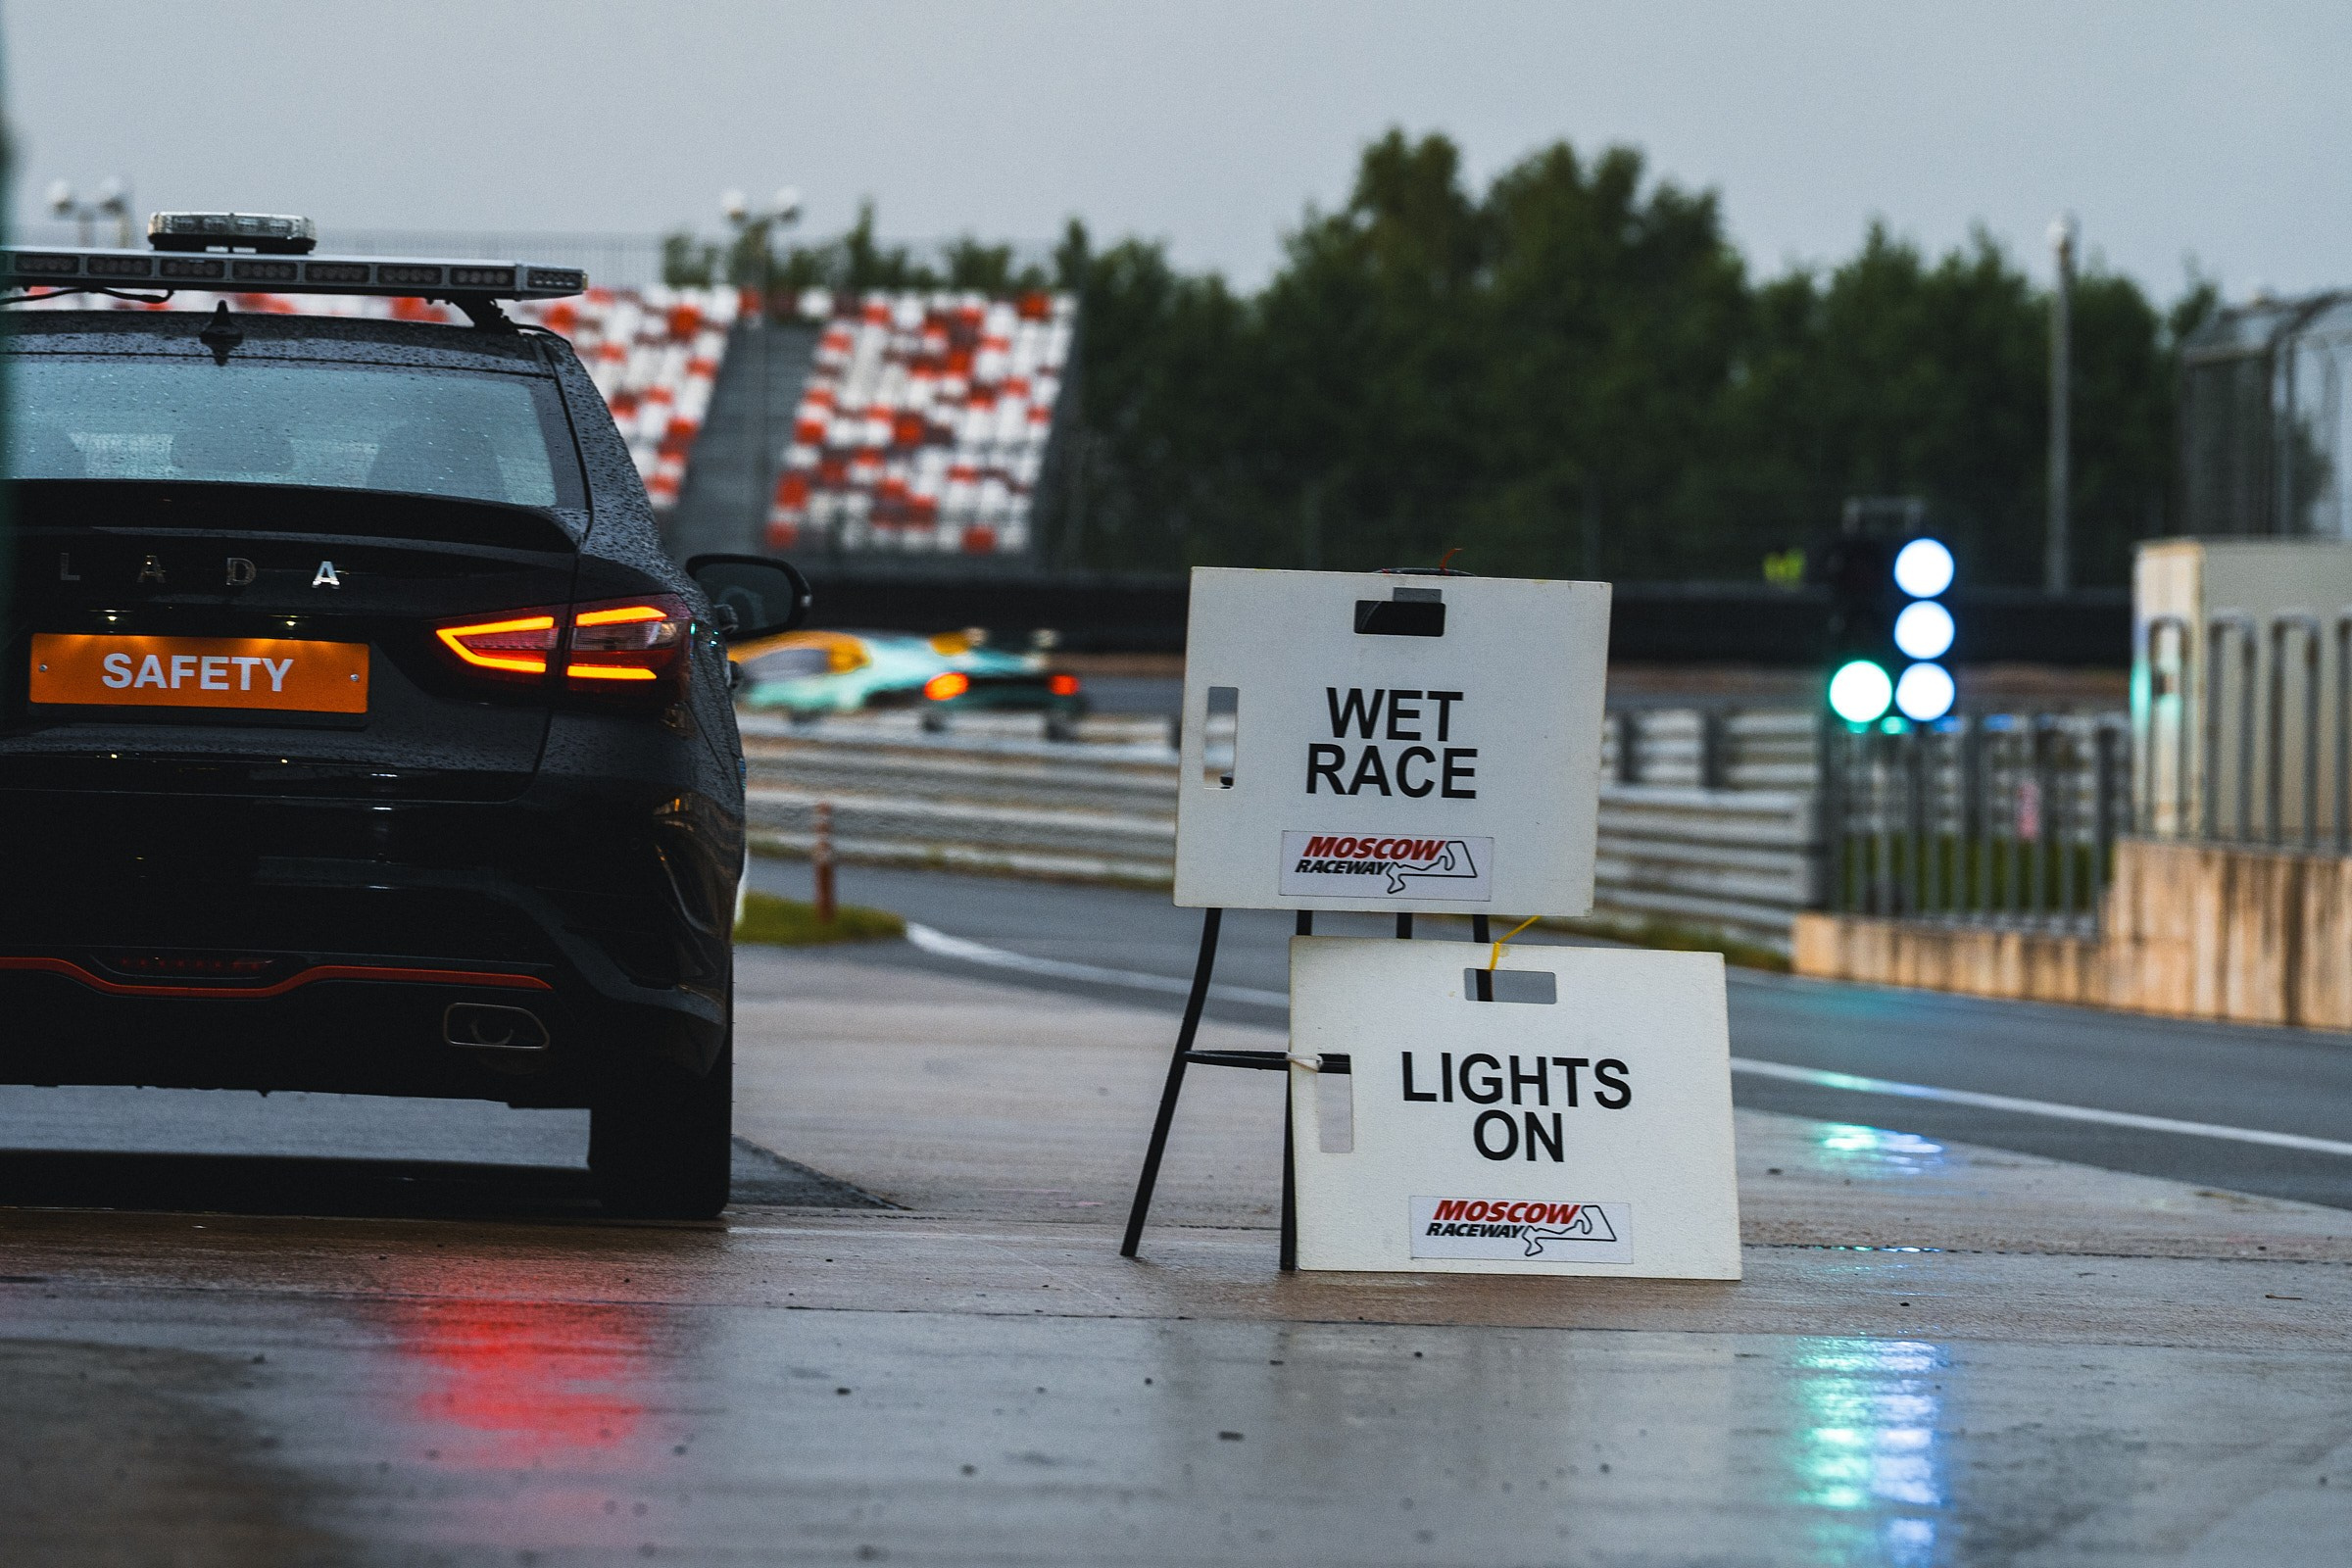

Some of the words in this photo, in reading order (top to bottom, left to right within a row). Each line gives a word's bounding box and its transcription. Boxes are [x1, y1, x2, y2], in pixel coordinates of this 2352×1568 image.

[60, 553, 342, 588] LADA
[101, 653, 294, 692] SAFETY
[1326, 687, 1464, 742] WET
[1305, 743, 1478, 800] RACE
[1303, 836, 1446, 860] MOSCOW
[1295, 859, 1390, 875] RACEWAY
[1401, 1052, 1632, 1109] LIGHTS
[1473, 1109, 1564, 1162] ON
[1426, 1222, 1525, 1239] RACEWAY
[1433, 1200, 1581, 1225] MOSCOW
